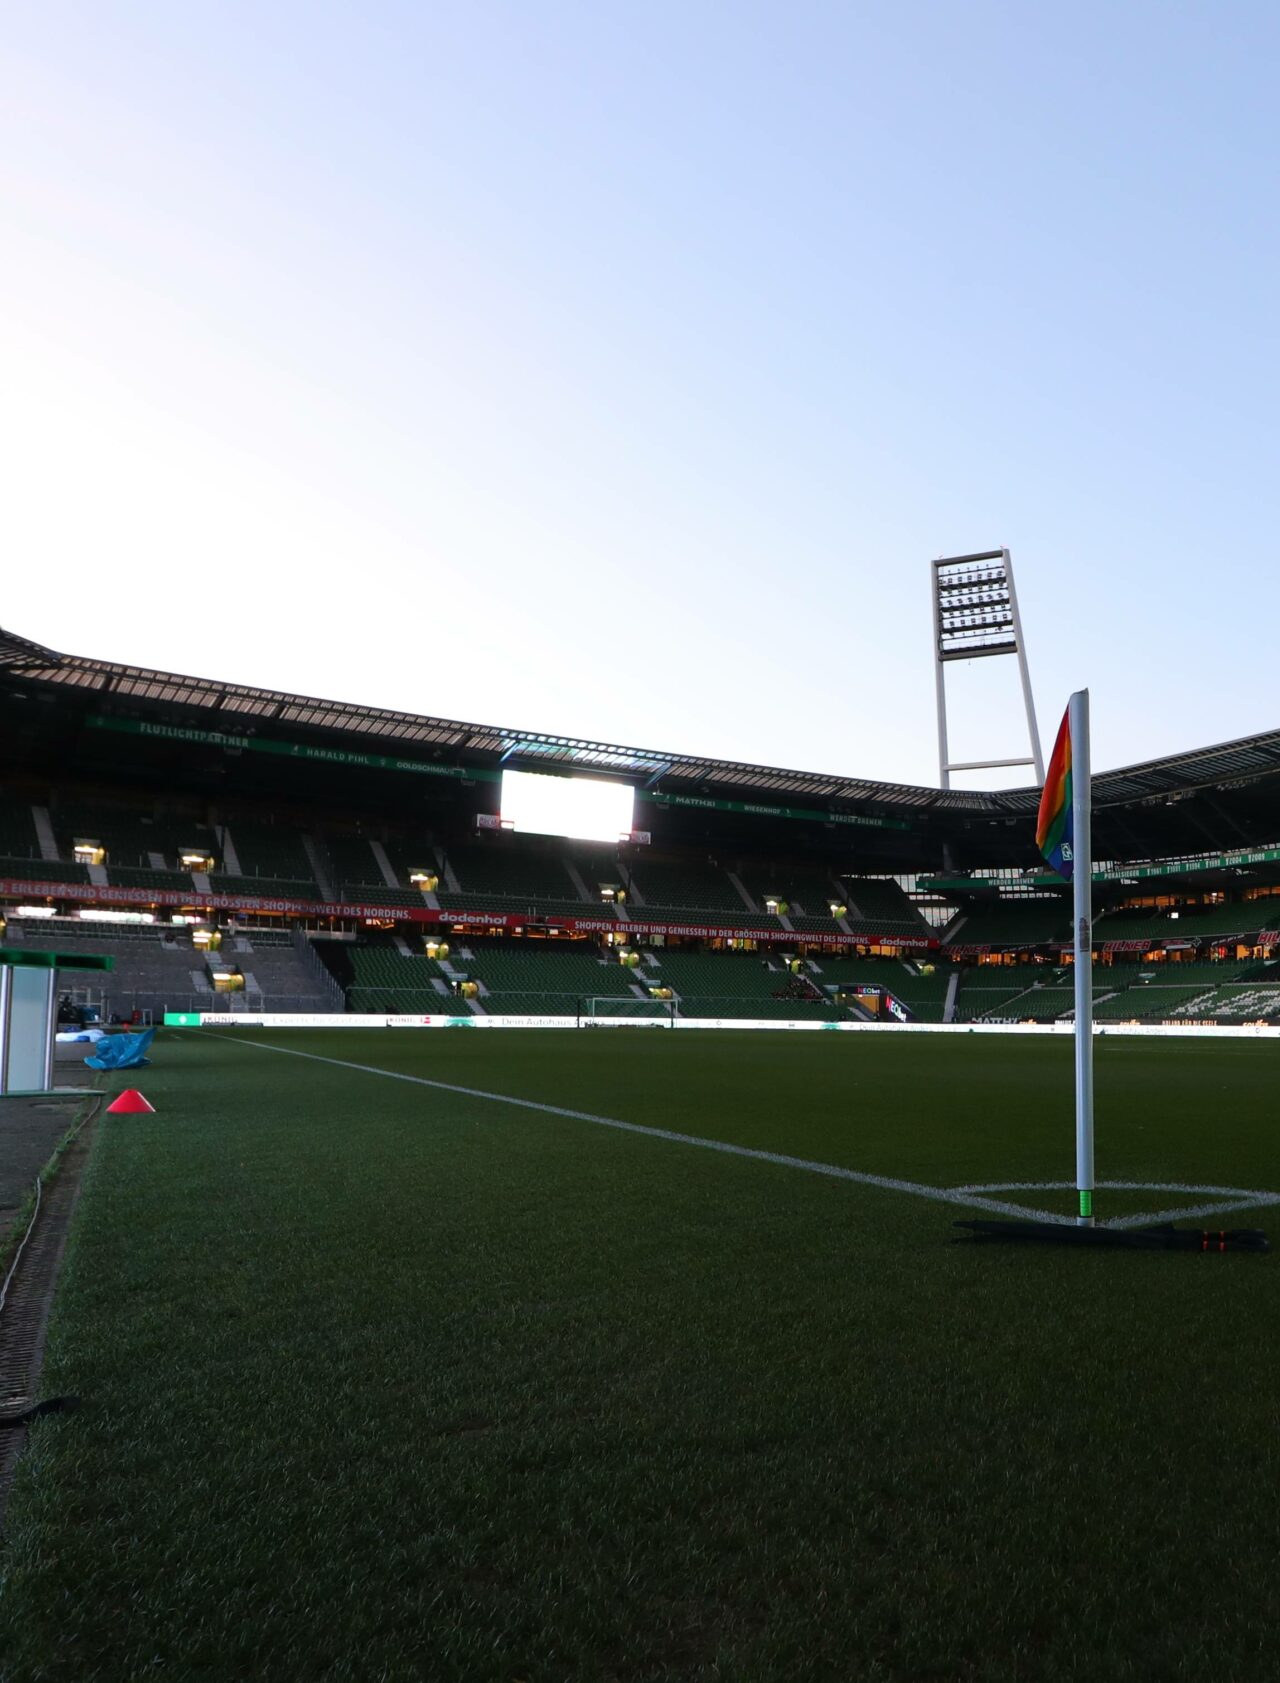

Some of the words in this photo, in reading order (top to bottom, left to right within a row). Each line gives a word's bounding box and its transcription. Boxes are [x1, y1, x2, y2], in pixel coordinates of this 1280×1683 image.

[140, 722, 249, 748] FLUTLICHTPARTNER
[306, 748, 345, 761] HARALD
[348, 753, 370, 765] PIHL
[743, 804, 781, 815] WIESENHOF
[857, 816, 883, 826] BREMEN
[1104, 869, 1140, 880] POKALSIEGER
[12, 885, 67, 898] ERLEBEN
[165, 893, 176, 904] IN
[344, 906, 361, 916] DES
[364, 907, 412, 920] NORDENS.
[438, 912, 508, 925] dodenhof
[574, 920, 614, 932] SHOPPEN,
[616, 923, 648, 934] ERLEBEN
[650, 925, 666, 935] UND
[669, 926, 708, 937] GENIESSEN
[709, 928, 717, 937] IN
[719, 929, 733, 938] DER
[734, 928, 770, 940] GRÖSSTEN
[771, 931, 823, 943] SHOPPINGWELT
[824, 934, 836, 943] DES
[837, 935, 871, 945] NORDENS.
[879, 937, 928, 948] dodenhof
[1103, 940, 1152, 952] HILKER
[942, 945, 991, 955] HILKER
